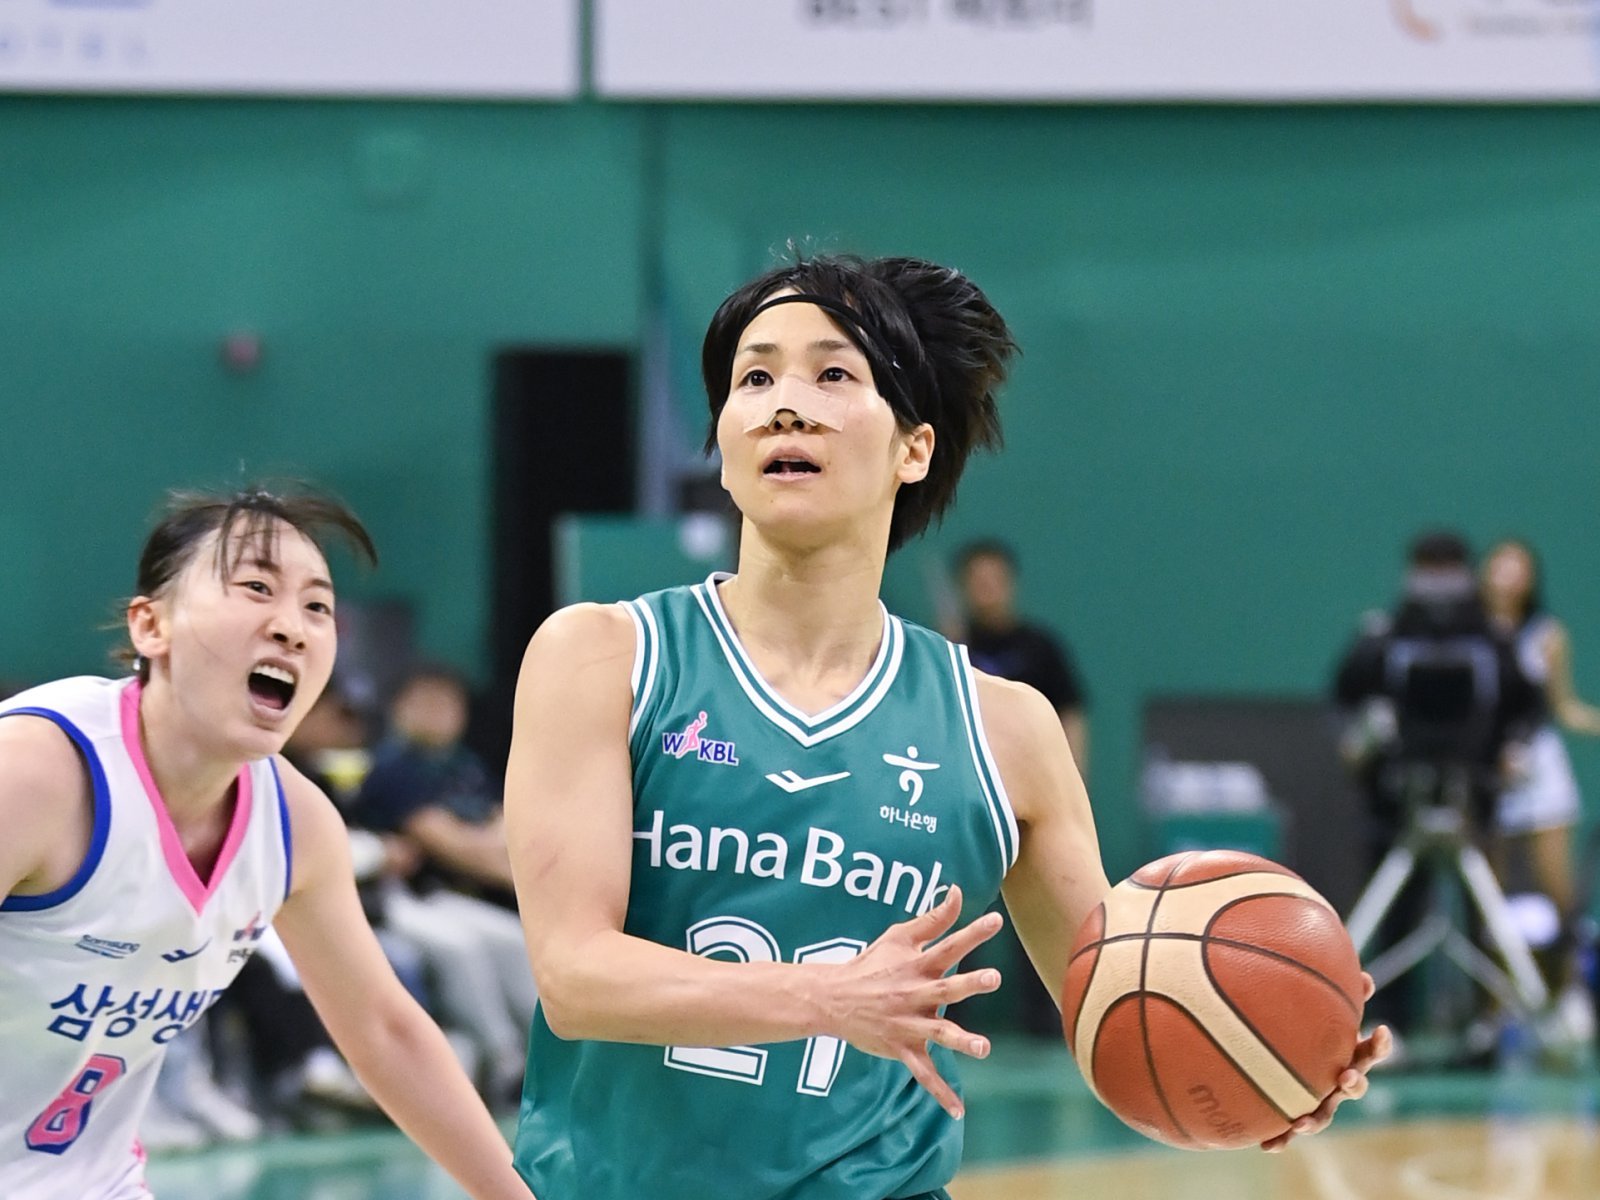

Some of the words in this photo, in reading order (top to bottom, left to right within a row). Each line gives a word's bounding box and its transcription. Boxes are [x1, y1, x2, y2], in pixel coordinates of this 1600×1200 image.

[880, 805, 938, 834] 하나은행
[633, 810, 789, 880] Hana
[800, 826, 953, 918] Bank
[47, 983, 224, 1044] 삼성생
[25, 1053, 126, 1155] 8
